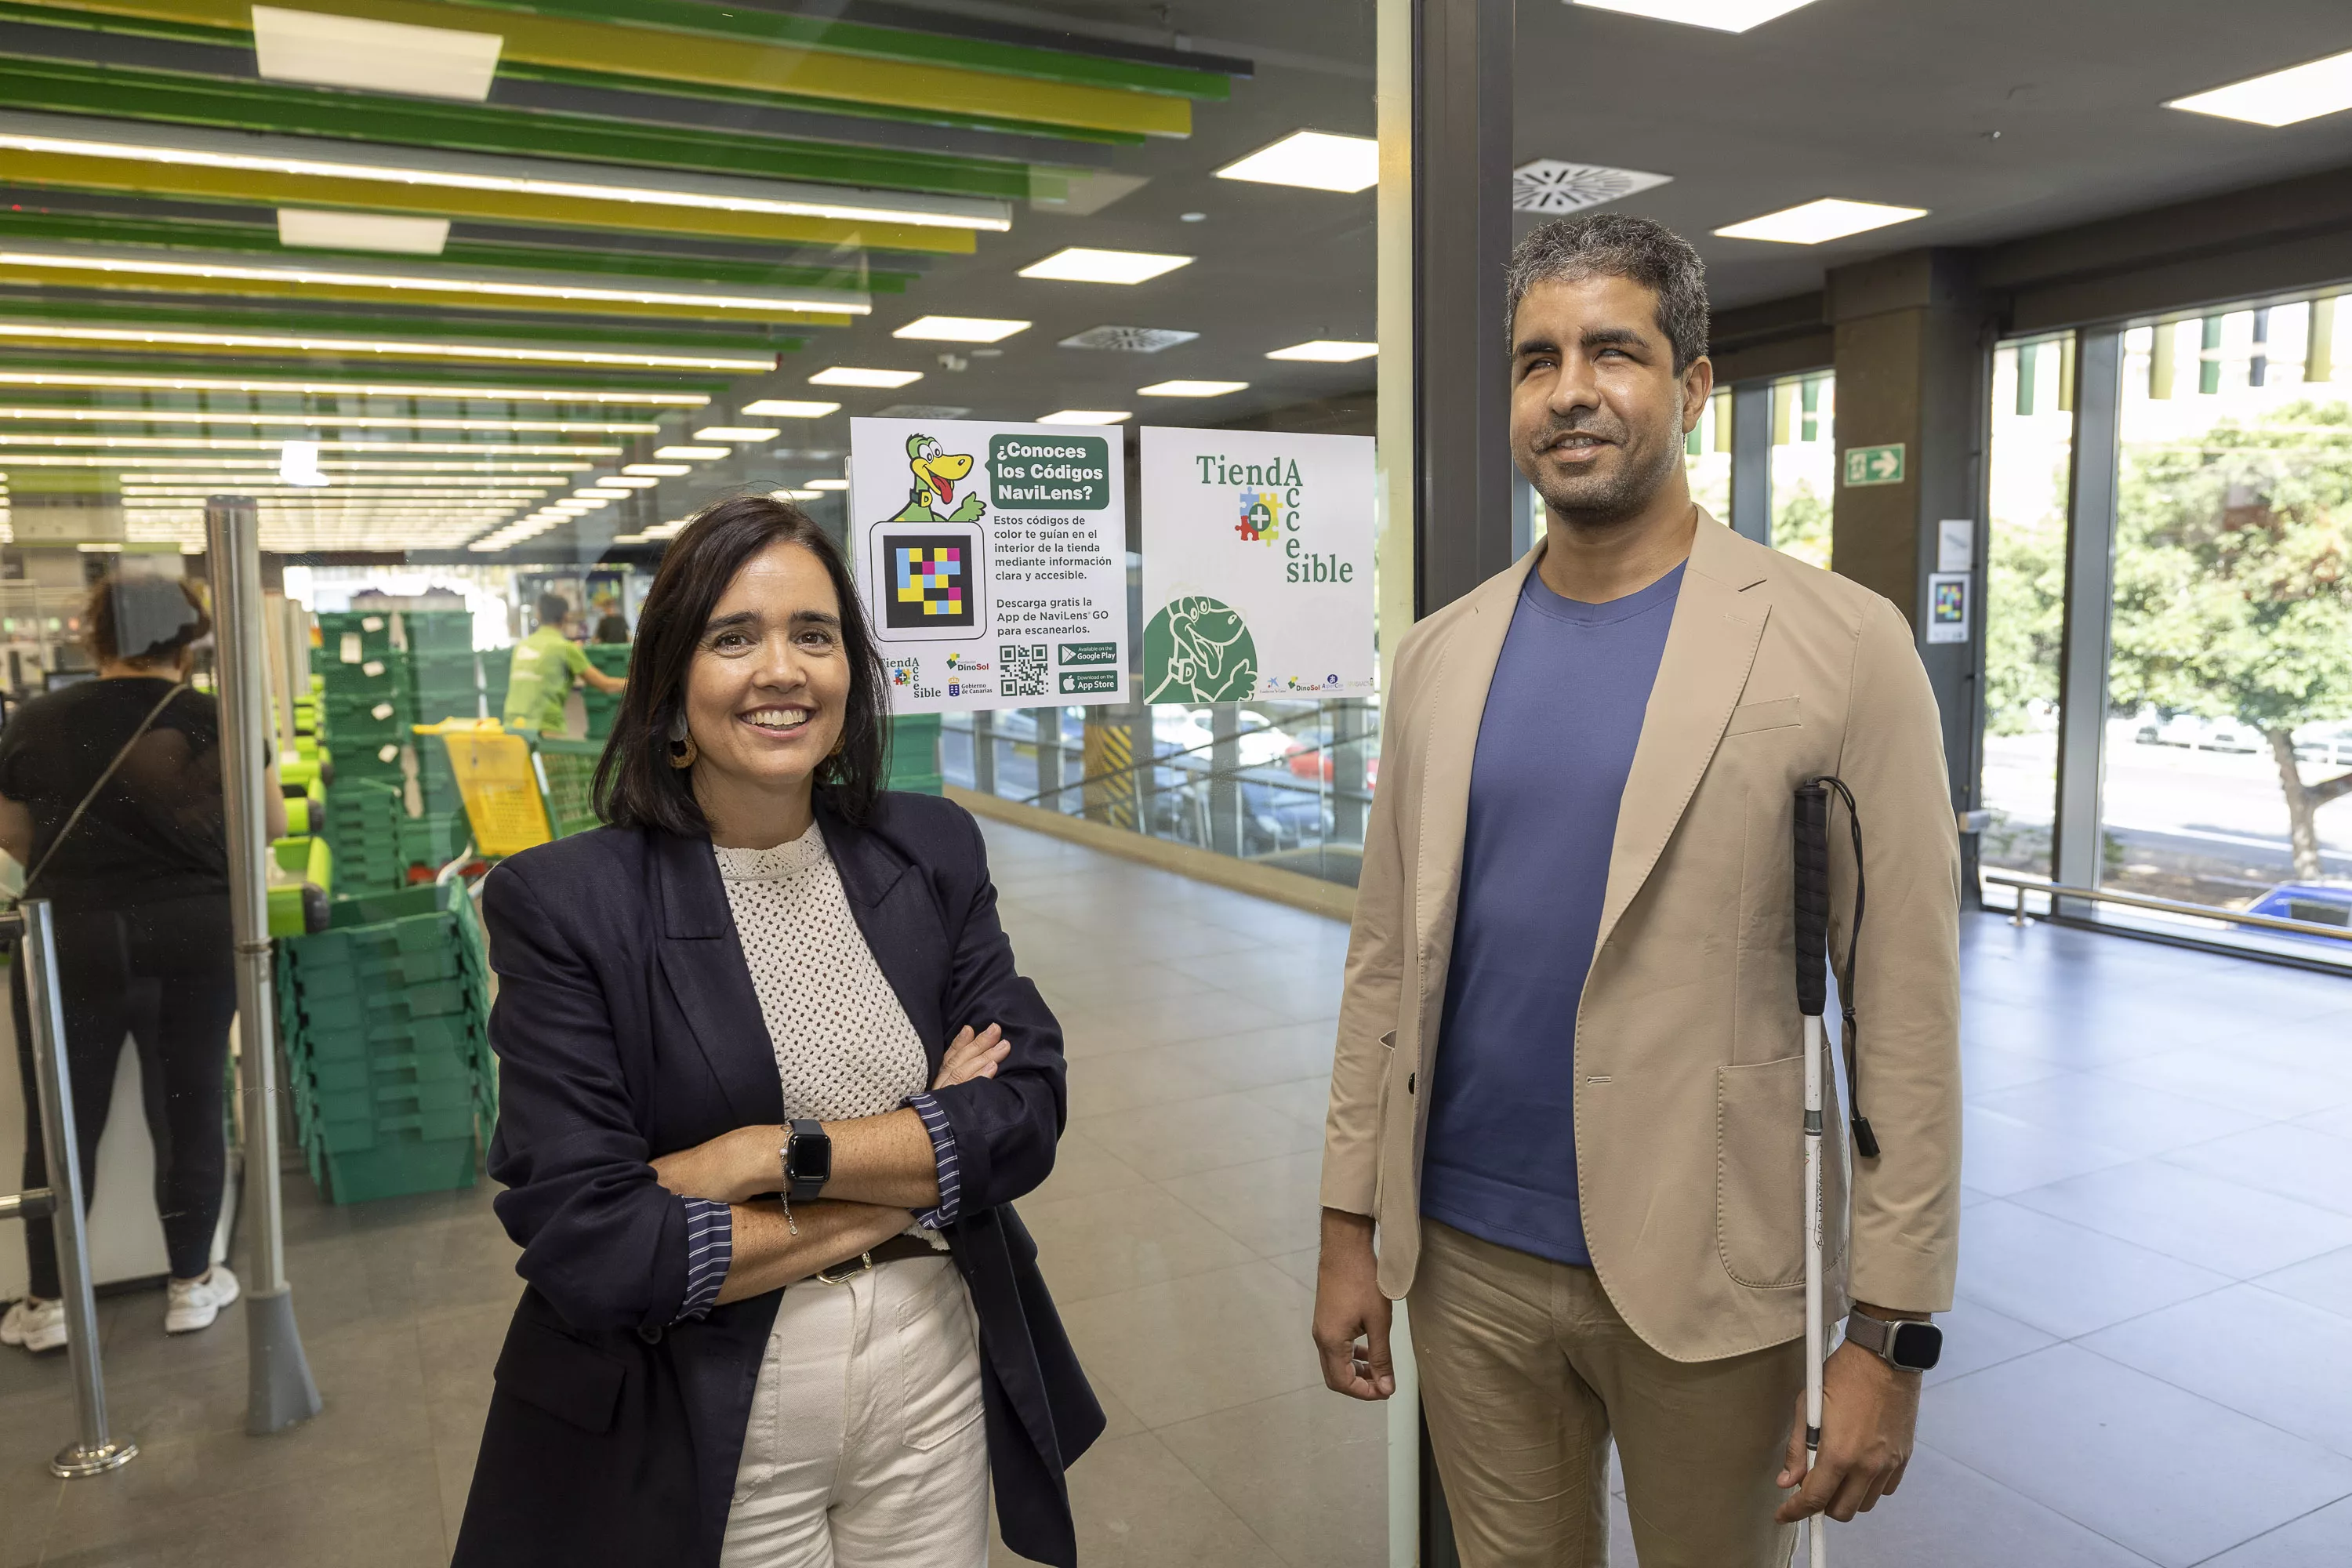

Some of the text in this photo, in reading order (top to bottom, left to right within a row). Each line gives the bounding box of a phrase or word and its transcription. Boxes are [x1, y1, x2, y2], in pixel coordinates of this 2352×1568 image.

[997, 442, 1086, 460] ¿Conoces
[998, 463, 1102, 482] los Códigos
[1196, 455, 1303, 487] TiendA
[999, 485, 1092, 499] NaviLens?
[994, 516, 1085, 526] Estos códigos de
[1040, 529, 1069, 540] guían
[995, 543, 1099, 552] interior de la tienda
[996, 557, 1111, 566] mediante información
[996, 572, 1022, 580] clara
[1035, 571, 1087, 579] accesible.
[997, 597, 1091, 608] Descarga gratis la
[997, 613, 1019, 623] App
[1023, 612, 1036, 621] de
[1025, 625, 1090, 634] escanearlos.
[1077, 652, 1100, 661] Google
[1077, 681, 1093, 690] App
